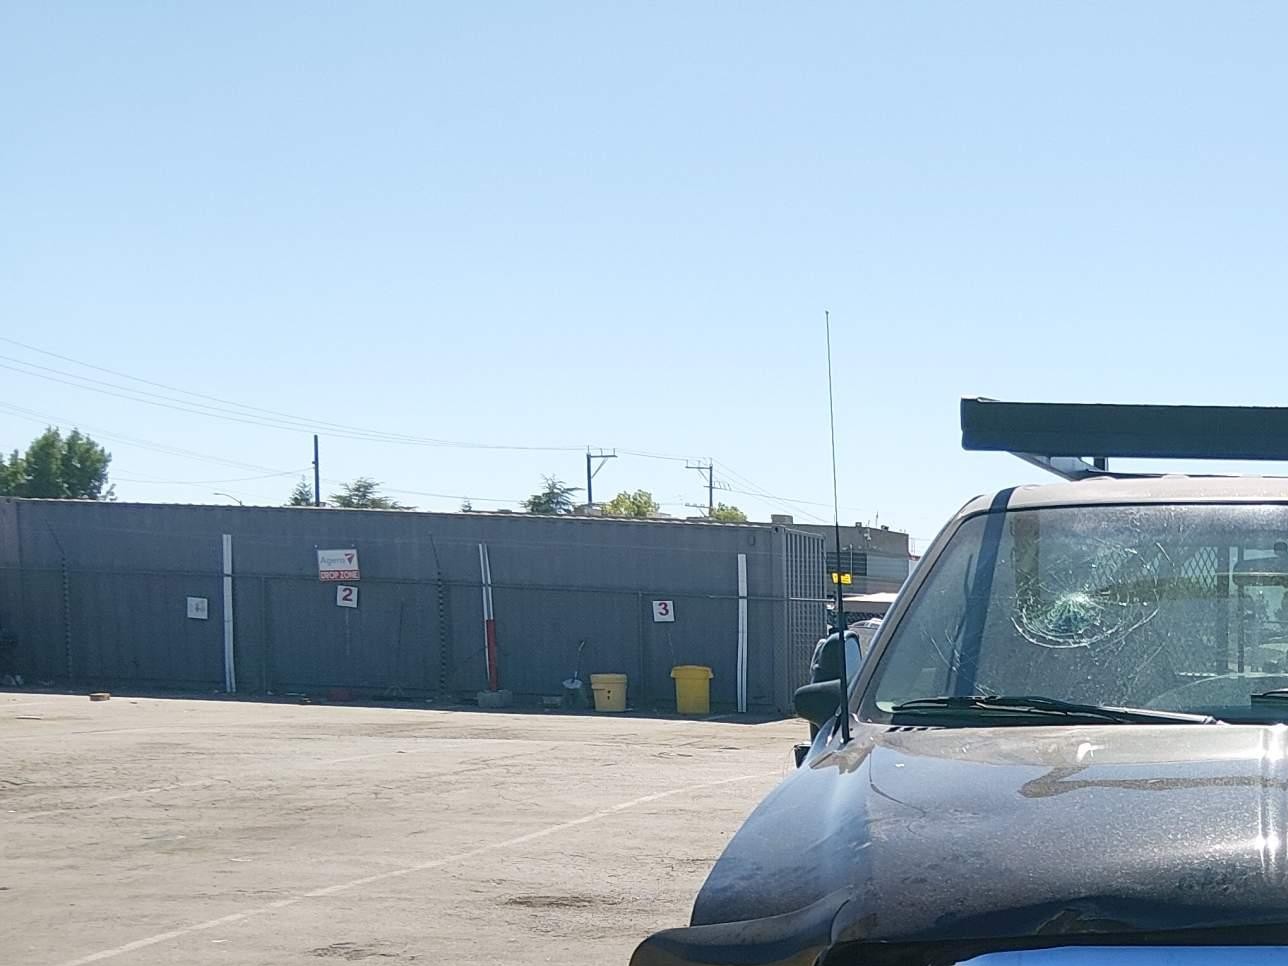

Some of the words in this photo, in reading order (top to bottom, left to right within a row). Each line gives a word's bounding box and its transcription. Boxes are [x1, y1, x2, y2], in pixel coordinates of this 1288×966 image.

[320, 570, 339, 580] DROP
[340, 570, 361, 580] ZONE
[342, 587, 353, 602] 2
[658, 601, 670, 617] 3
